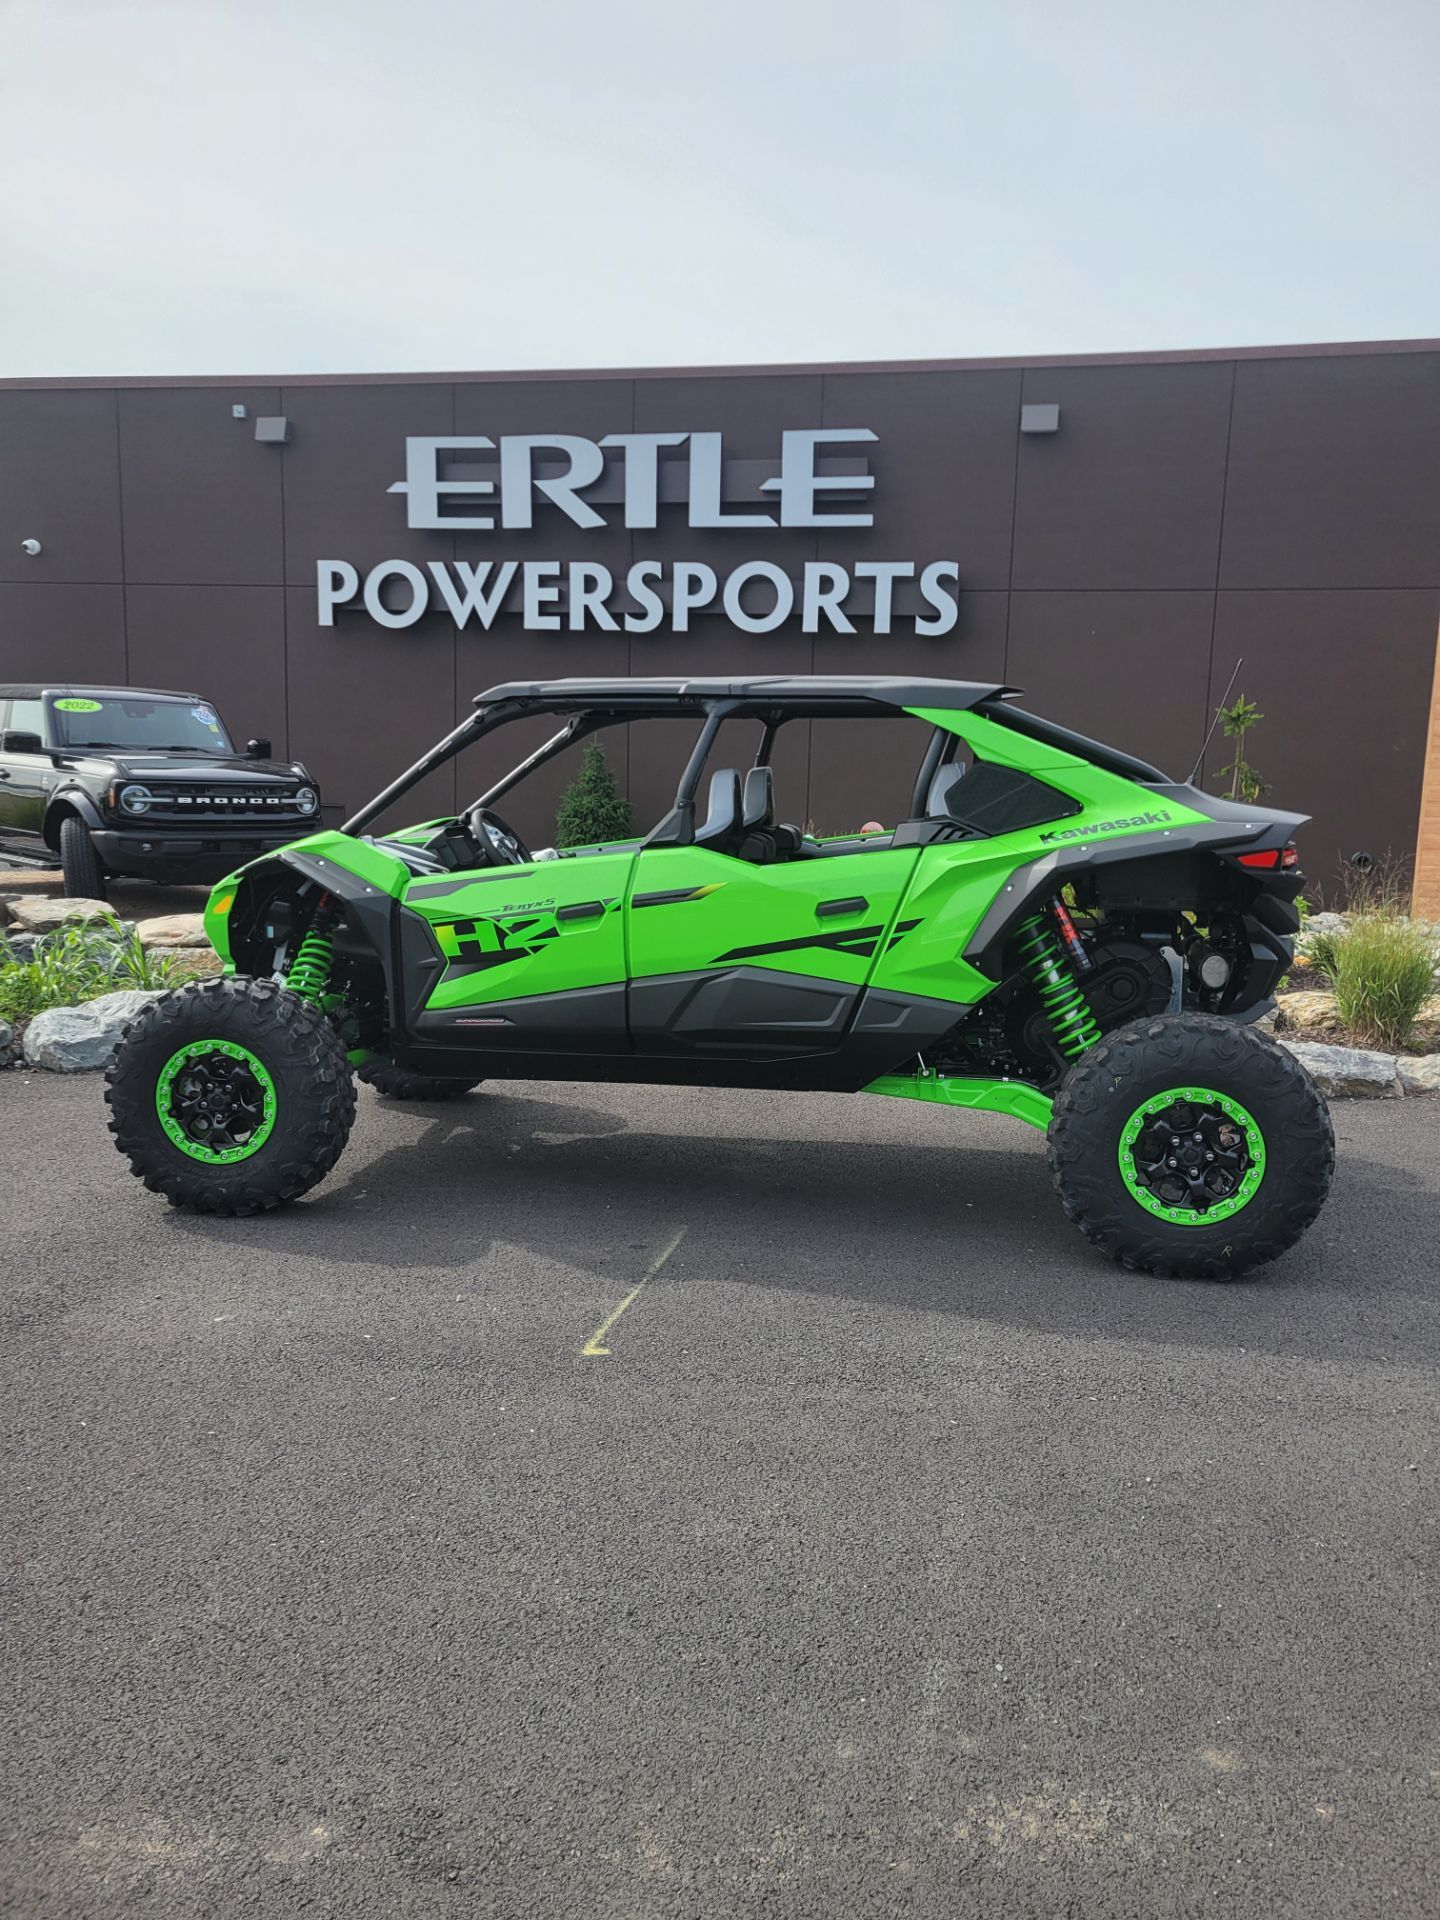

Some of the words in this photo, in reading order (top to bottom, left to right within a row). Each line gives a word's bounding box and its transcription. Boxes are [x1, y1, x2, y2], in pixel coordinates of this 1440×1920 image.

[387, 429, 879, 530] ERTLE
[317, 558, 960, 636] POWERSPORTS
[63, 701, 95, 710] 2022
[1039, 810, 1172, 845] Kawasaki
[435, 915, 560, 957] H2
